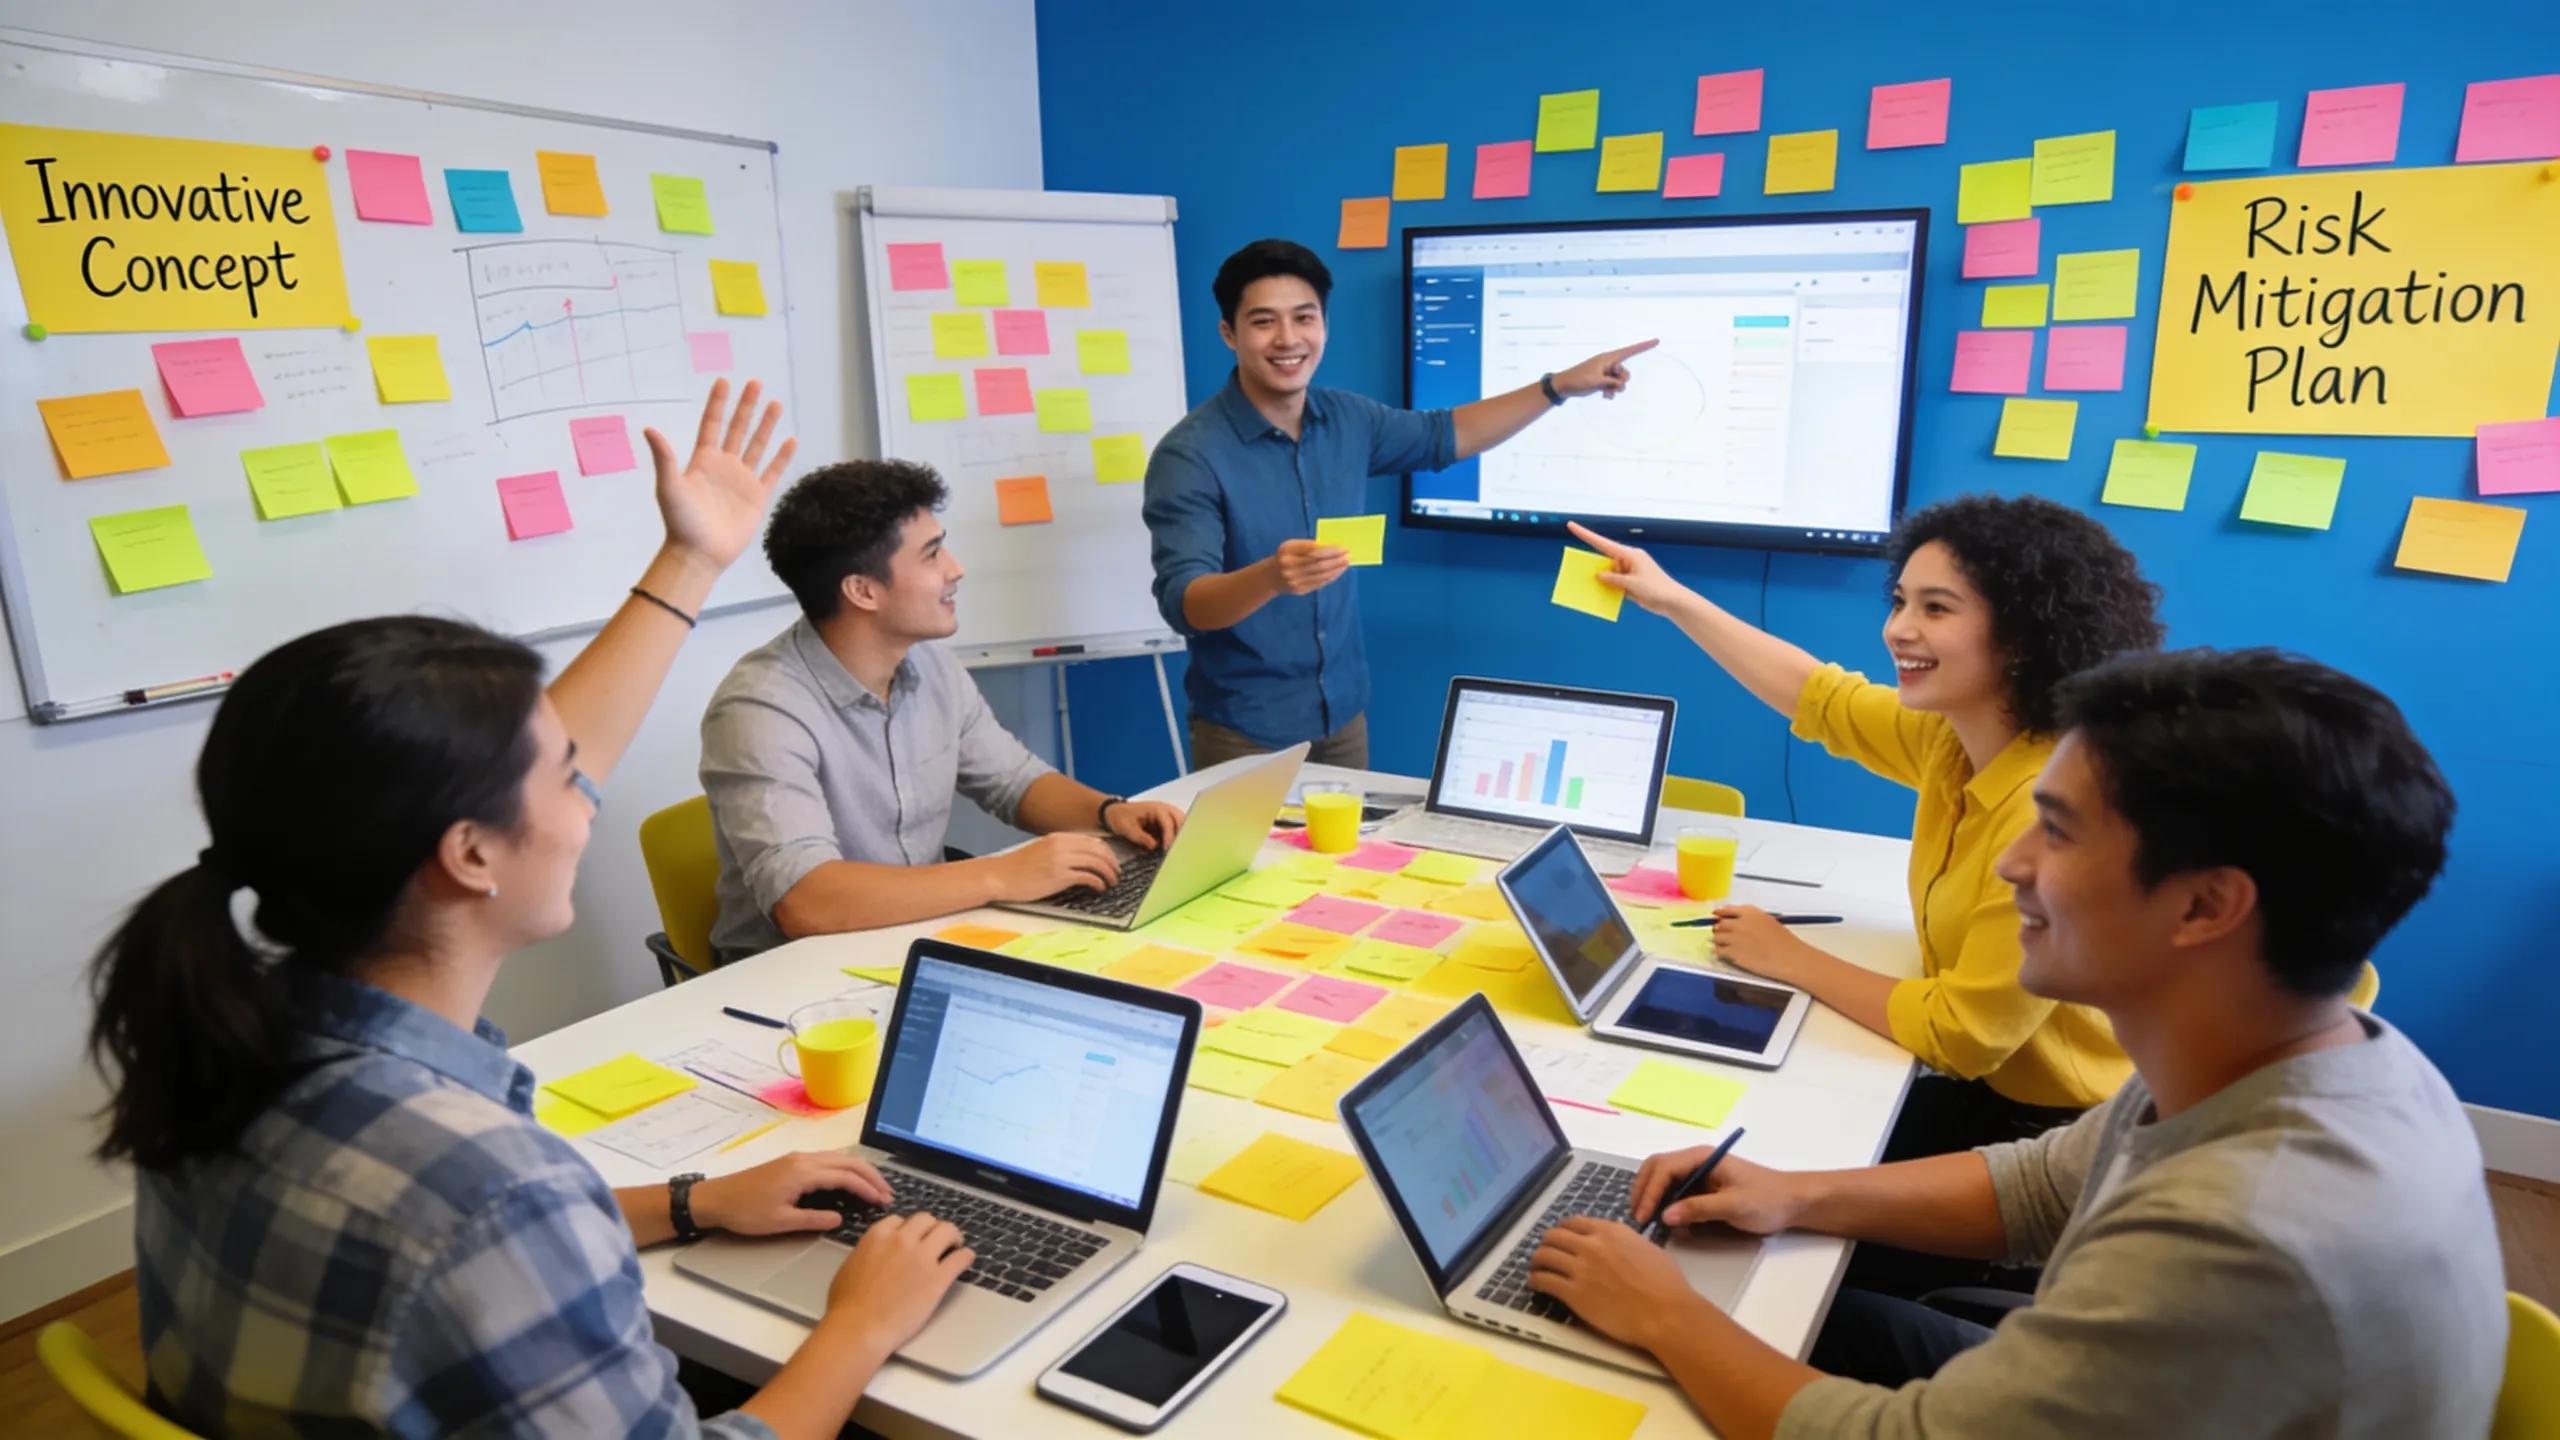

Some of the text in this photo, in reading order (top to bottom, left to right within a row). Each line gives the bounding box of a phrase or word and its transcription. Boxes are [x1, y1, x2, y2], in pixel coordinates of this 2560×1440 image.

[24, 157, 310, 225] Innovative
[2245, 190, 2391, 259] Risk
[81, 236, 298, 319] Concept
[2190, 270, 2524, 349] Mitigation
[2245, 345, 2387, 413] Plan
